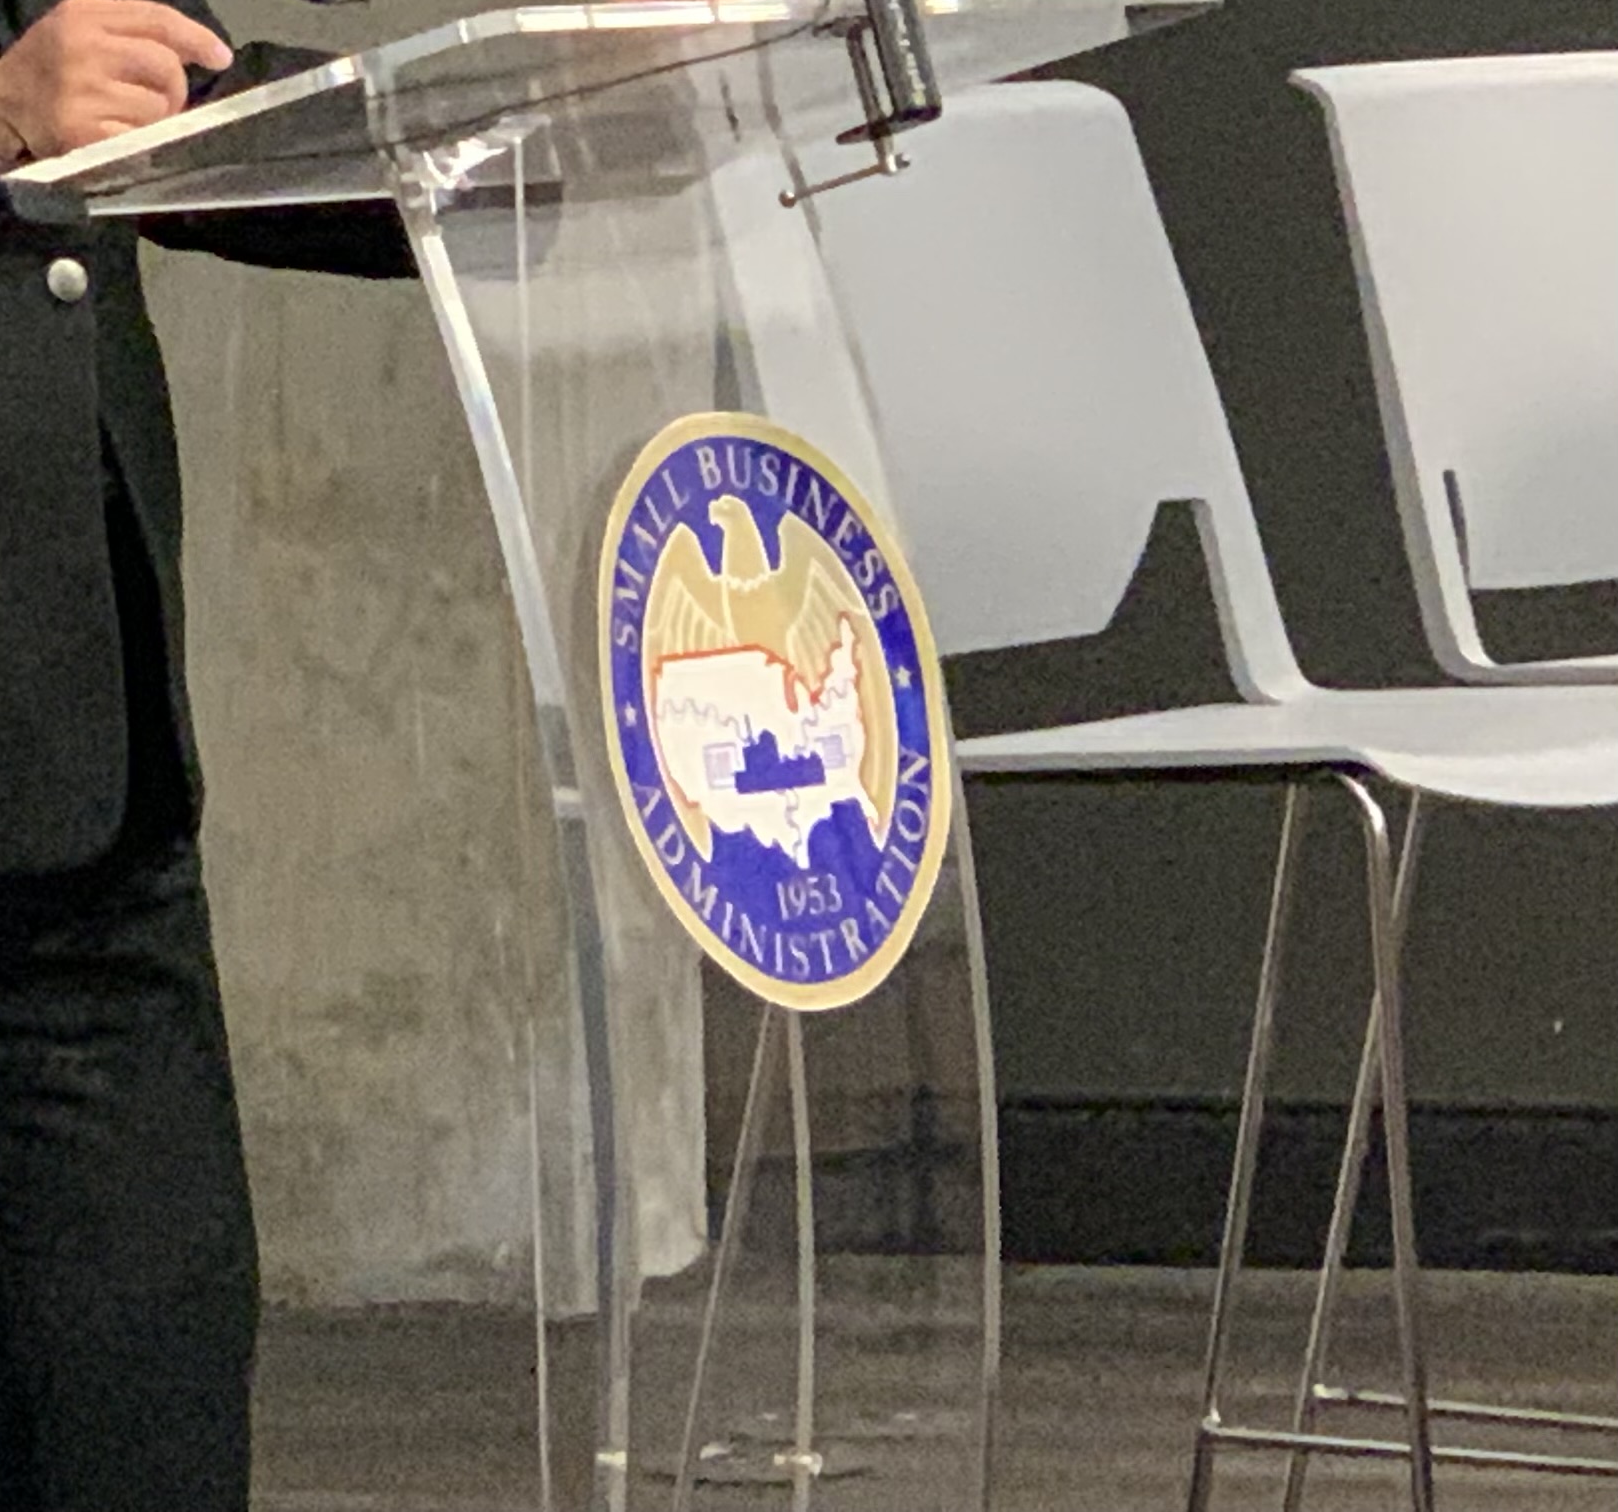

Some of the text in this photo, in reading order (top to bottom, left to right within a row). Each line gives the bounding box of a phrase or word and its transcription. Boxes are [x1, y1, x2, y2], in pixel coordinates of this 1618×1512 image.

[613, 443, 900, 654] SMALL BUSINESS
[632, 744, 932, 979] ADMINISTRATION
[775, 873, 843, 921] 1953
